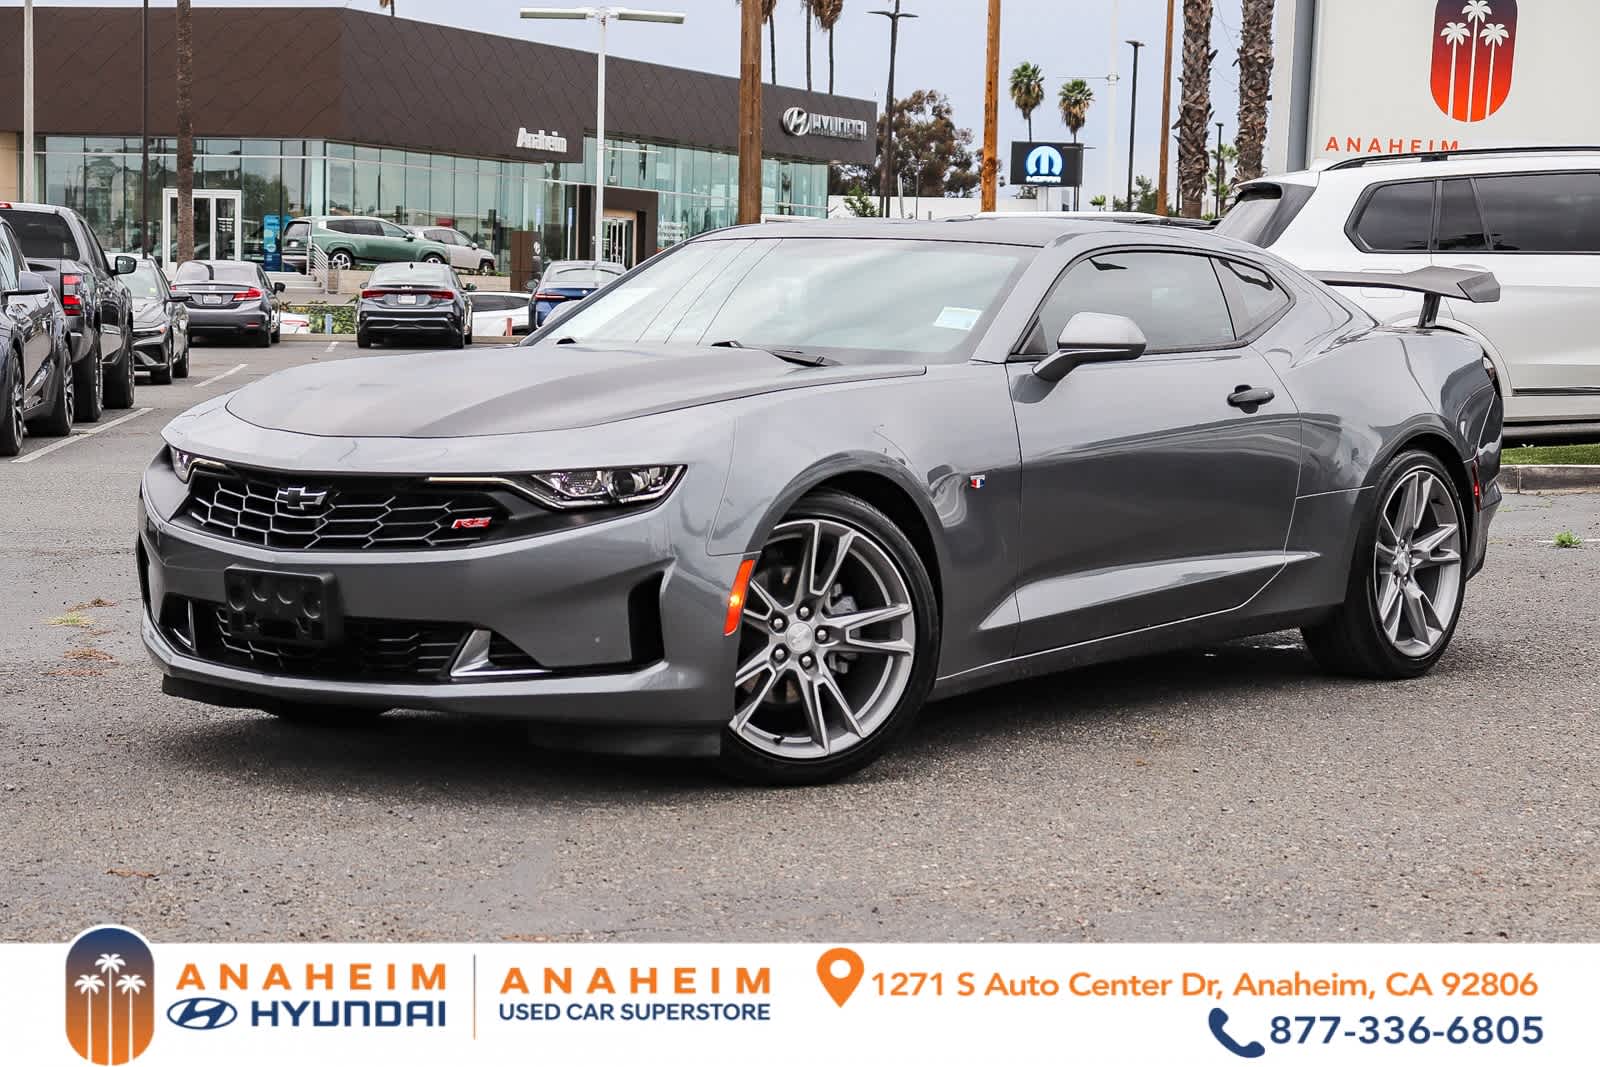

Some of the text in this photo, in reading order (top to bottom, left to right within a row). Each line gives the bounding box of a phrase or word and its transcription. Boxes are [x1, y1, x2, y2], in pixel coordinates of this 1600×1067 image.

[808, 112, 868, 140] HYUNDAI
[516, 127, 568, 153] Anaheim
[1325, 136, 1459, 153] ANAHEIM
[451, 517, 492, 529] RS
